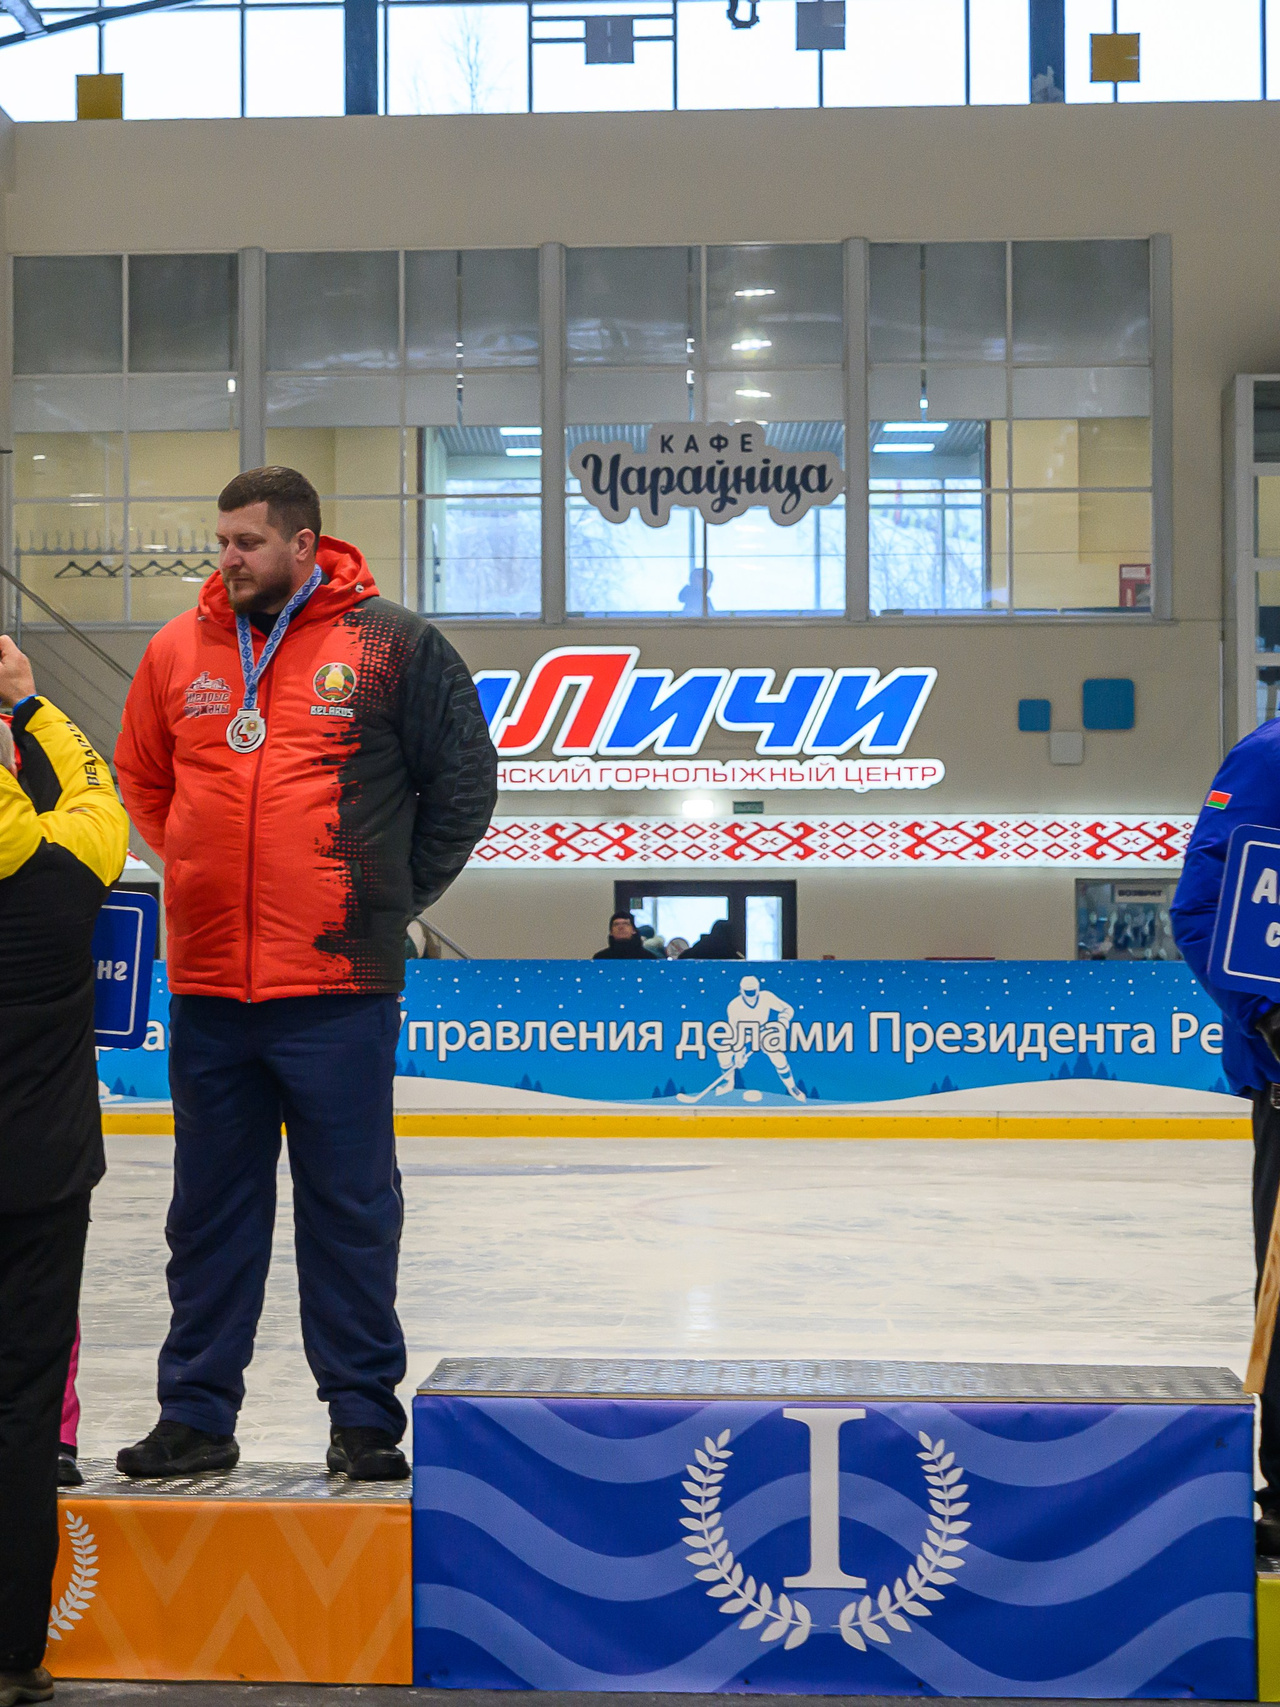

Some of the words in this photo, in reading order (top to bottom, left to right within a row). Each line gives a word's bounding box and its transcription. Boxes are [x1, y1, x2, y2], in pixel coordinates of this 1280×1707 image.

[660, 433, 753, 453] КАФЕ
[581, 453, 834, 516] Чараўніца
[310, 705, 354, 718] BELARUS
[598, 762, 836, 783] ГОРНОЛЫЖНЫЙ
[845, 765, 937, 787] ЦЕНТР
[400, 1010, 664, 1062] правления
[675, 1019, 854, 1060] делами
[869, 1011, 1157, 1064] Президента
